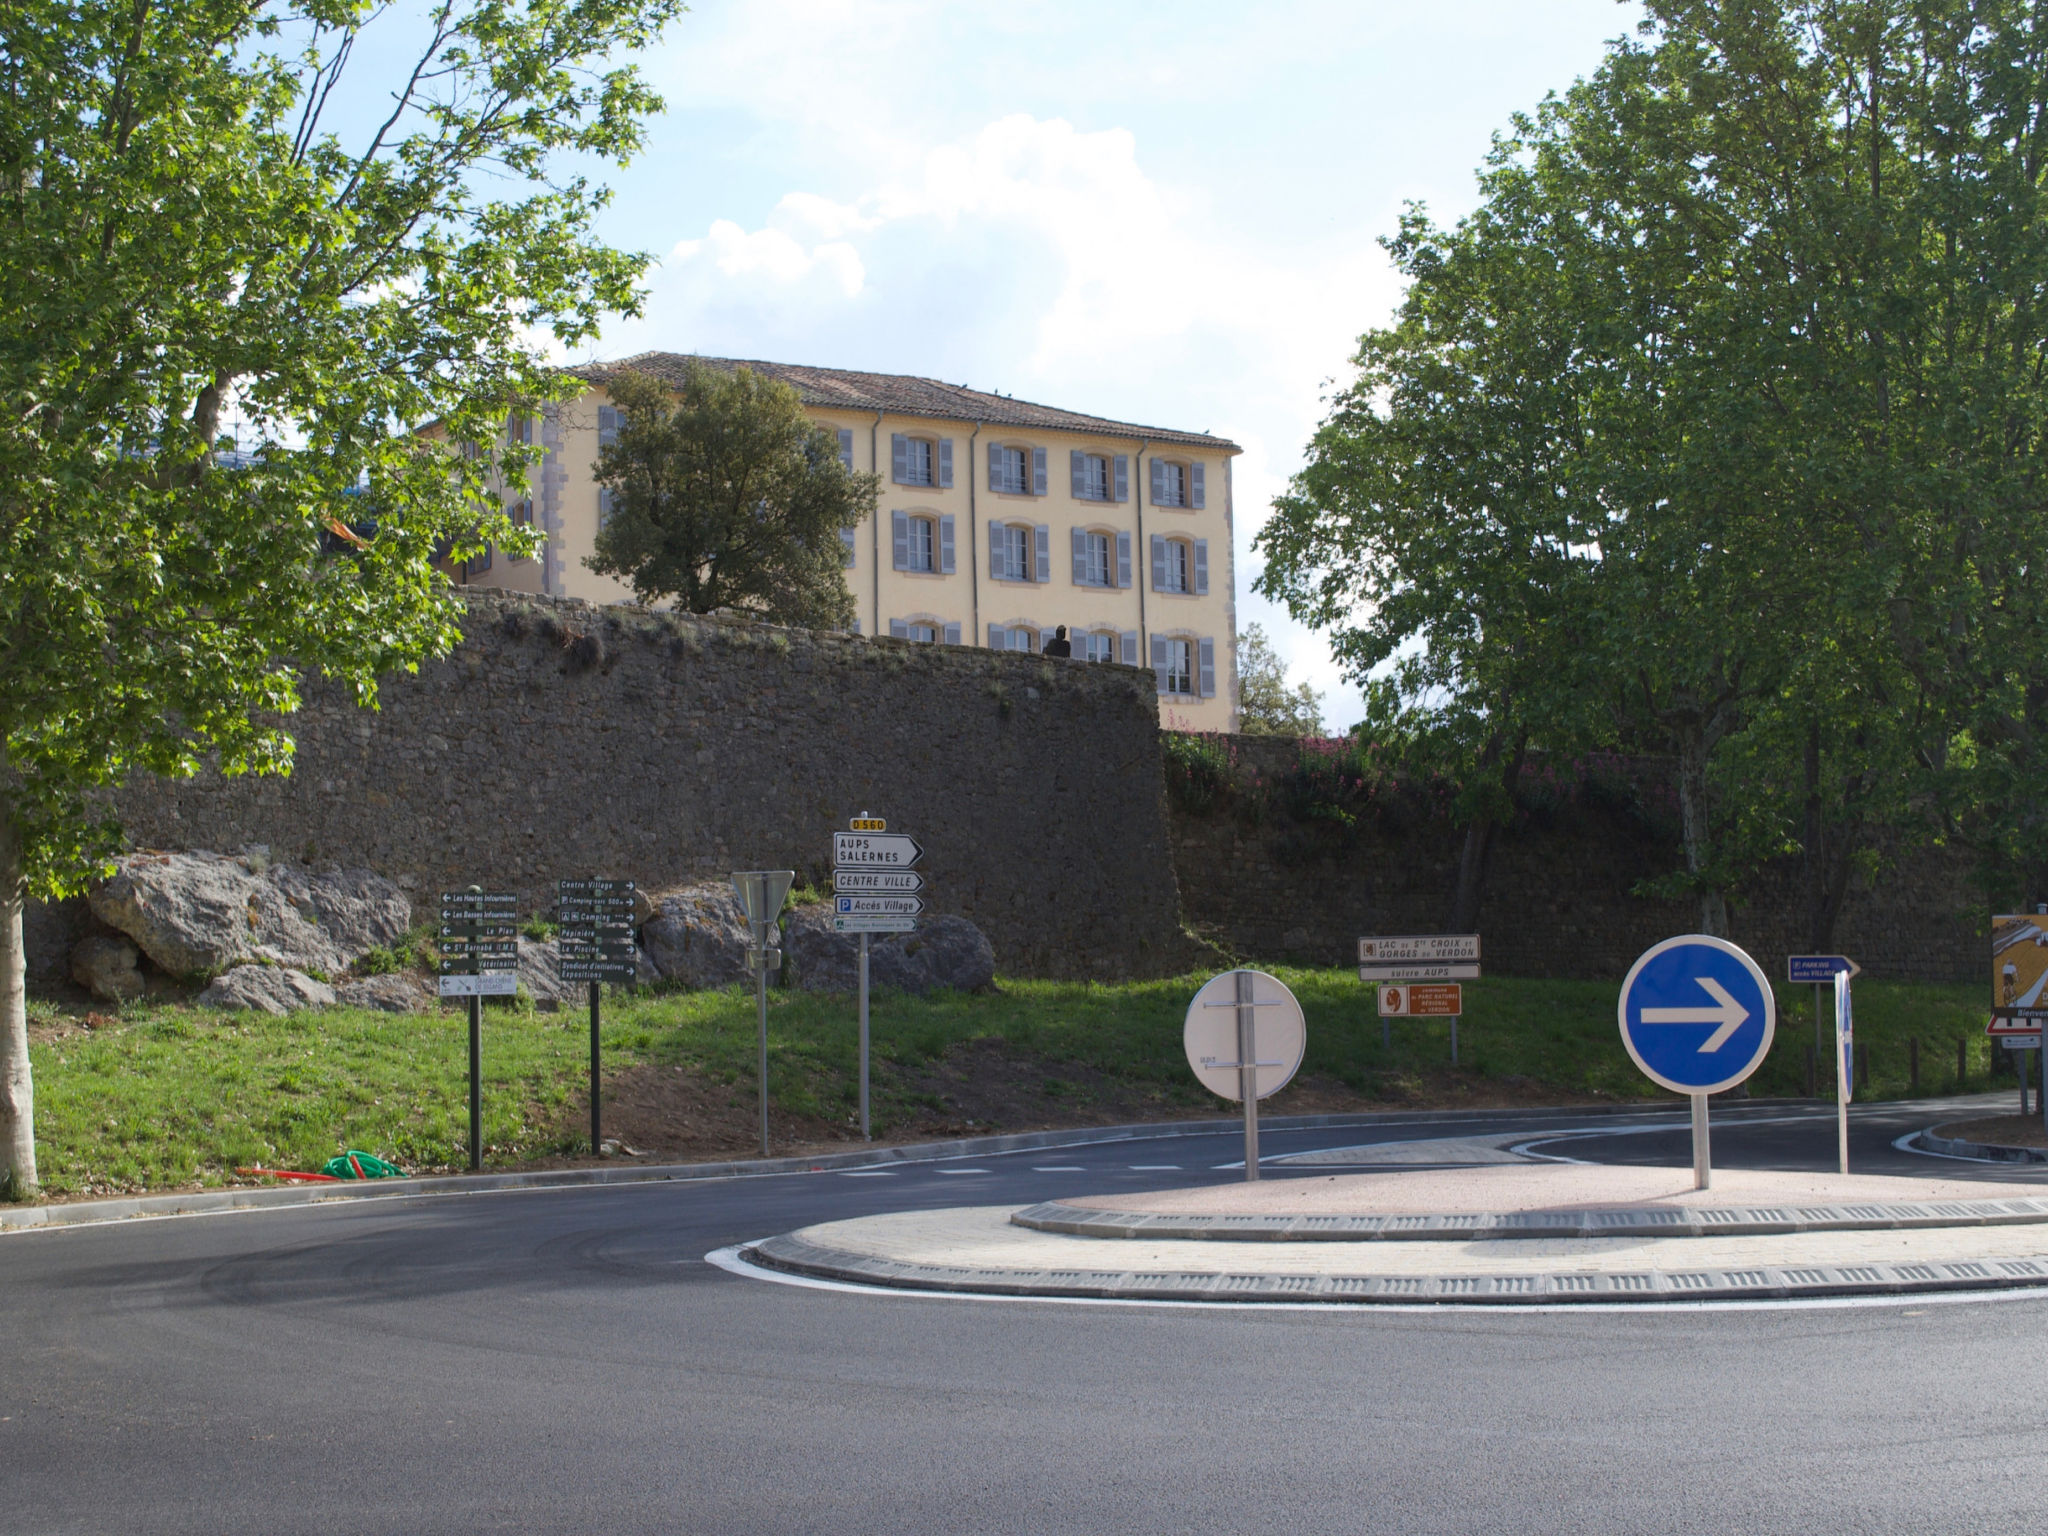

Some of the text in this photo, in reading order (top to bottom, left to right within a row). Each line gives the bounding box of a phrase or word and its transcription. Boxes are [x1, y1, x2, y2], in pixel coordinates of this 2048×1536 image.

[853, 821, 884, 830] D 560
[840, 839, 870, 849] AUPS
[840, 851, 899, 862] SALERNES
[561, 881, 613, 891] Centre Village
[840, 876, 911, 887] CENTRE VILLE
[453, 894, 463, 902] Les
[464, 894, 483, 902] Hautes
[884, 900, 914, 912] Village
[453, 911, 463, 919] Les
[581, 913, 610, 923] Camping
[498, 927, 514, 935] Plan
[561, 929, 595, 938] Pépinière
[464, 944, 493, 952] Barnabé
[561, 945, 600, 953] La Piscine
[1379, 941, 1397, 950] LAC
[1431, 939, 1460, 949] CROIX
[1380, 950, 1417, 959] GORGES
[1435, 949, 1474, 958] VERDON
[479, 961, 517, 969] Vétérinaire
[561, 970, 602, 979] Expositions
[1424, 968, 1449, 977] AUPS
